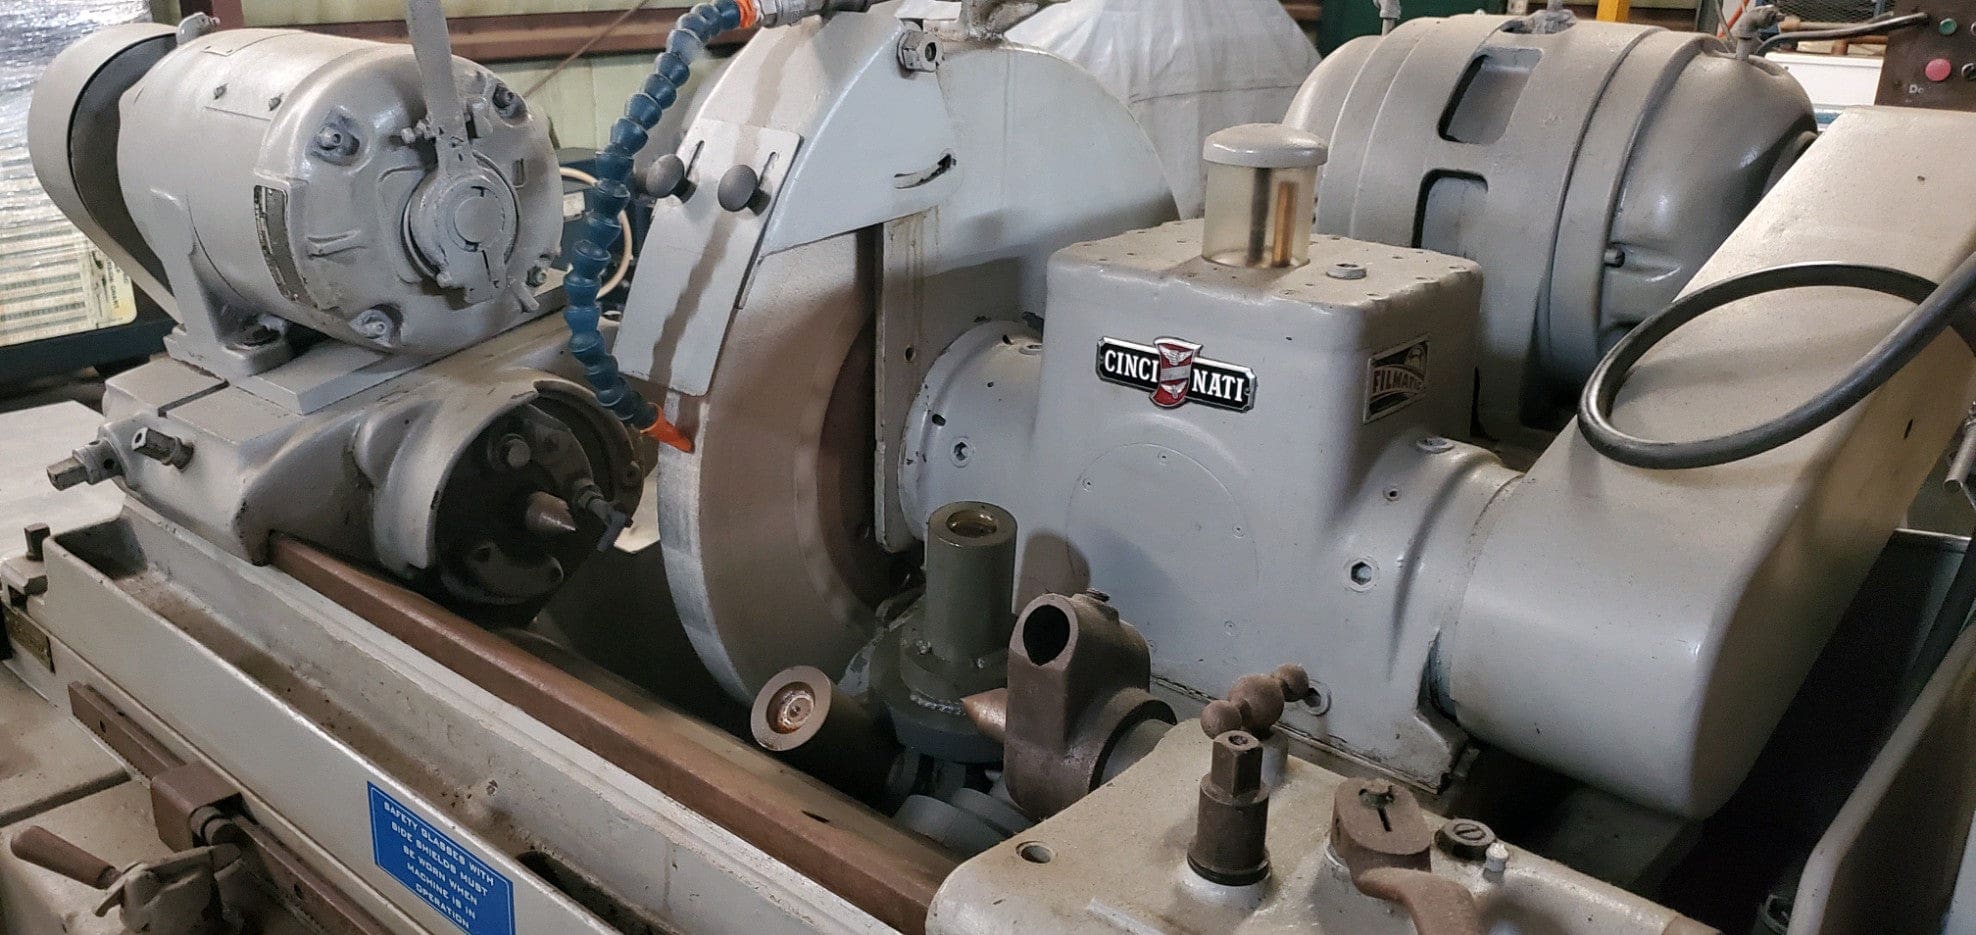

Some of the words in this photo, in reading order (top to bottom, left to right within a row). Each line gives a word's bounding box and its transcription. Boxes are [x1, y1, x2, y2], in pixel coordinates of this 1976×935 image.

[1372, 366, 1424, 396] FILMATIC
[384, 801, 418, 829] SAFETY
[421, 828, 466, 865] GLASSES
[469, 862, 494, 886] WITH
[391, 821, 413, 842] SIDE
[416, 840, 457, 874] SHIELDS
[460, 872, 488, 896] MUST
[403, 845, 415, 860] BE
[418, 856, 446, 882] WORN
[449, 878, 478, 906] WHEN
[407, 863, 449, 899] MACHINE
[452, 896, 462, 909] IS
[465, 907, 476, 920] IN
[415, 884, 470, 929] OPERATION
